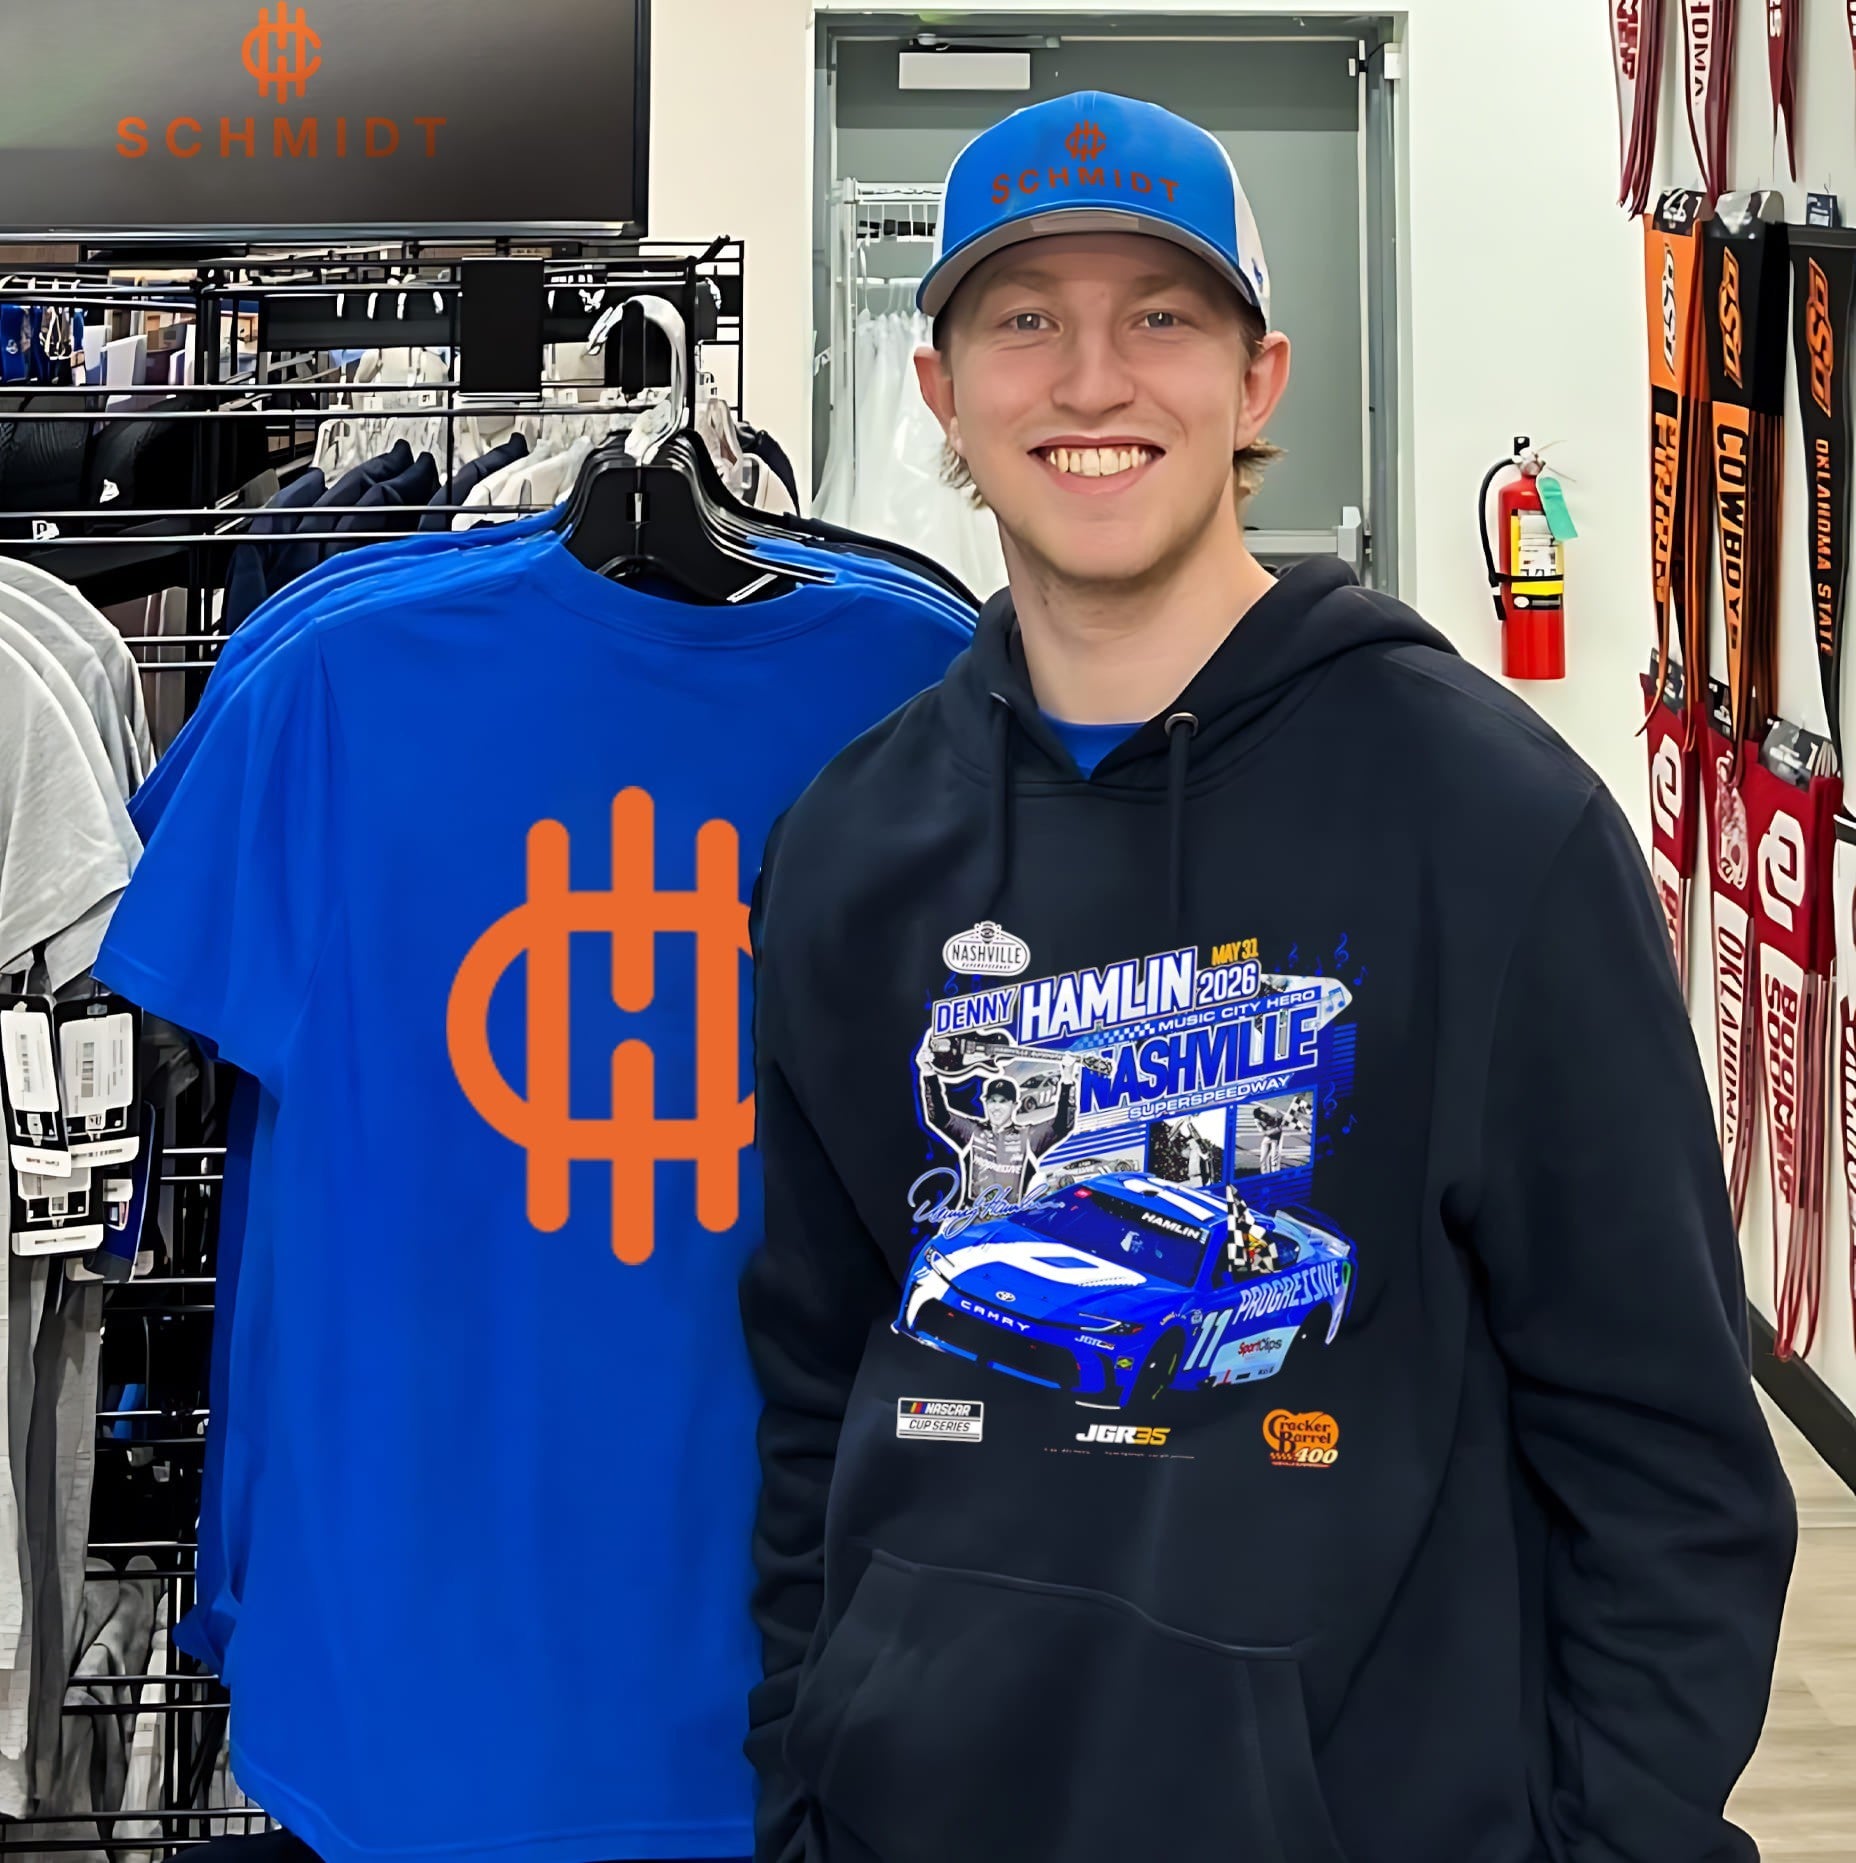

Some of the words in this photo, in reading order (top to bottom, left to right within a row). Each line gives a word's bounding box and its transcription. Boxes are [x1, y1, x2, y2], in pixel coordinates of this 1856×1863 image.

[116, 117, 447, 158] SCHMIDT
[992, 167, 1179, 204] SCHMIDT
[1815, 438, 1832, 570] OKLAHOMA
[952, 944, 1022, 964] NASHVILLE
[1211, 941, 1241, 966] MAY
[1241, 937, 1259, 960] 31
[936, 989, 1016, 1035] DENNY
[1019, 948, 1195, 1045] HAMLIN
[1198, 961, 1258, 1005] 2026
[1158, 1010, 1216, 1032] MUSIC
[1221, 1001, 1262, 1022] CITY
[1266, 989, 1316, 1009] HERO
[1081, 1004, 1318, 1115] NASHVILLE
[1128, 1074, 1292, 1120] SUPERSPEEDWAY
[1141, 1211, 1200, 1239] HAMLIN
[1231, 1260, 1340, 1326] PROGRESSIVE
[960, 1300, 1031, 1332] CAMRY
[1183, 1308, 1234, 1371] 11
[909, 1419, 932, 1430] CUP
[932, 1420, 971, 1432] SERIES
[924, 1402, 972, 1416] NASCAR
[1075, 1423, 1171, 1446] JGR35
[1268, 1414, 1331, 1440] Cracker
[1279, 1431, 1331, 1454] Barrel
[1295, 1447, 1339, 1464] 400
